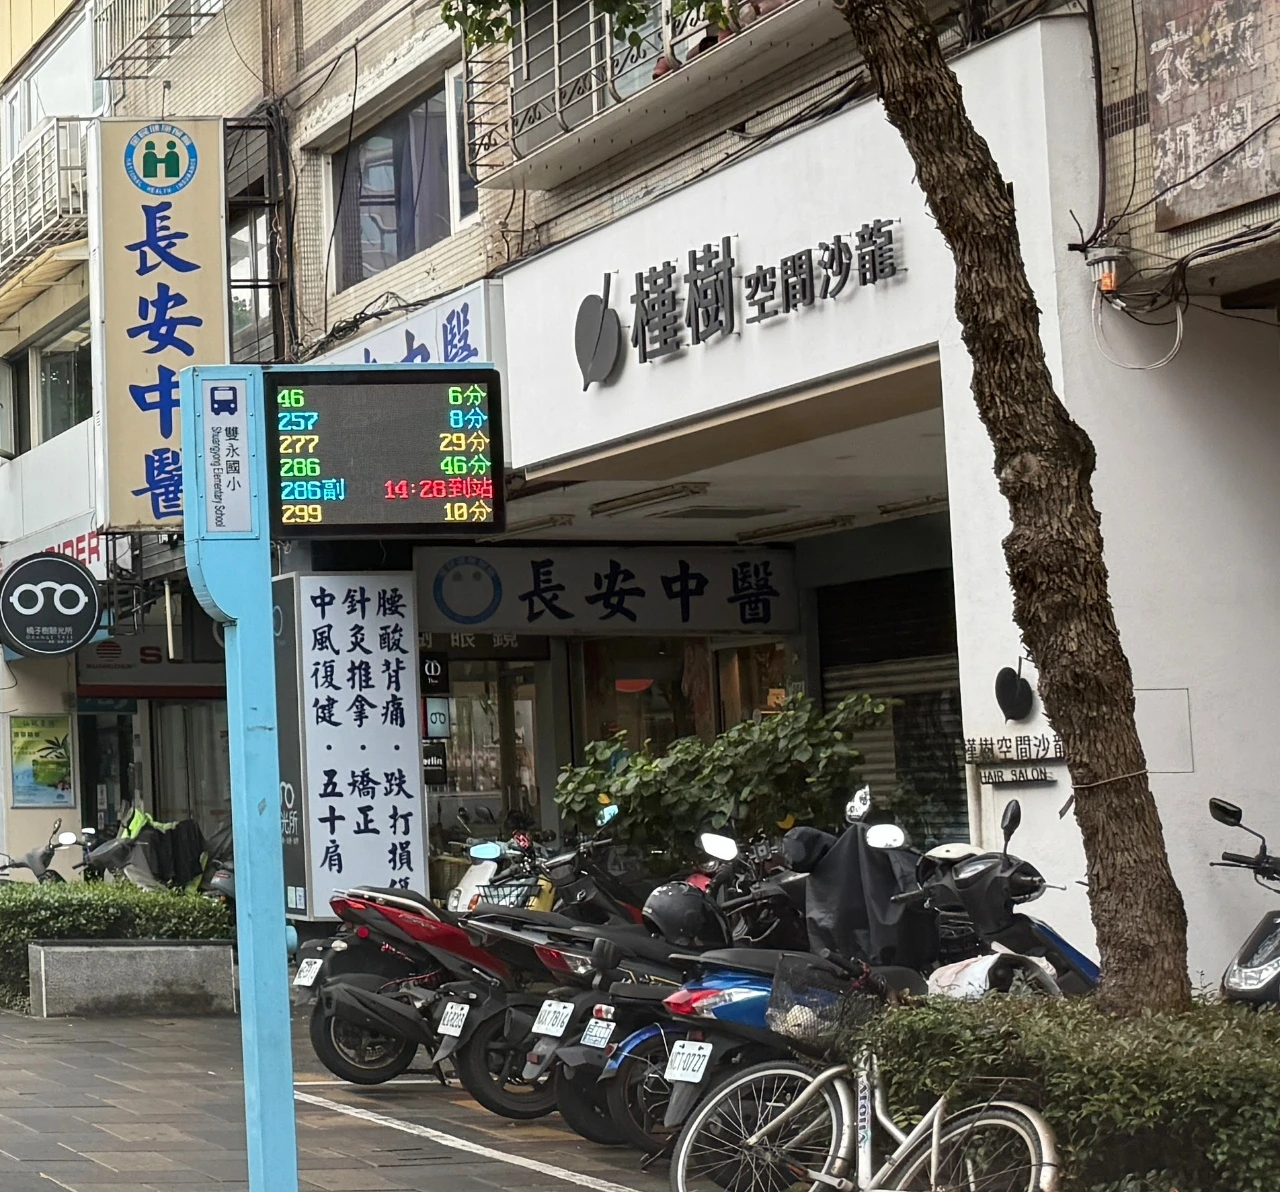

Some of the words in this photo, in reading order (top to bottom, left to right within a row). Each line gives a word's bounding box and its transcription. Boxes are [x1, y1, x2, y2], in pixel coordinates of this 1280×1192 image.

[146, 186, 172, 194] HEALTH
[630, 235, 736, 364] 槿樹
[745, 219, 897, 325] 空間沙龍
[124, 201, 202, 521] 長安中醫
[278, 389, 304, 407] 46
[448, 384, 487, 406] 6分
[278, 412, 318, 430] 257
[450, 407, 488, 429] 8分
[279, 435, 319, 454] 277
[439, 430, 490, 452] 29分
[225, 427, 241, 491] 雙永國小
[280, 458, 320, 477] 286
[440, 453, 491, 476] 46分
[212, 468, 224, 503] Elementary
[281, 478, 345, 501] 286副
[384, 477, 493, 499] 14:28到站
[215, 505, 225, 528] School
[282, 504, 322, 523] 299
[444, 500, 493, 522] 10分
[518, 557, 780, 625] 長安中醫
[981, 770, 1005, 783] HAIR
[1011, 767, 1048, 781] SALON
